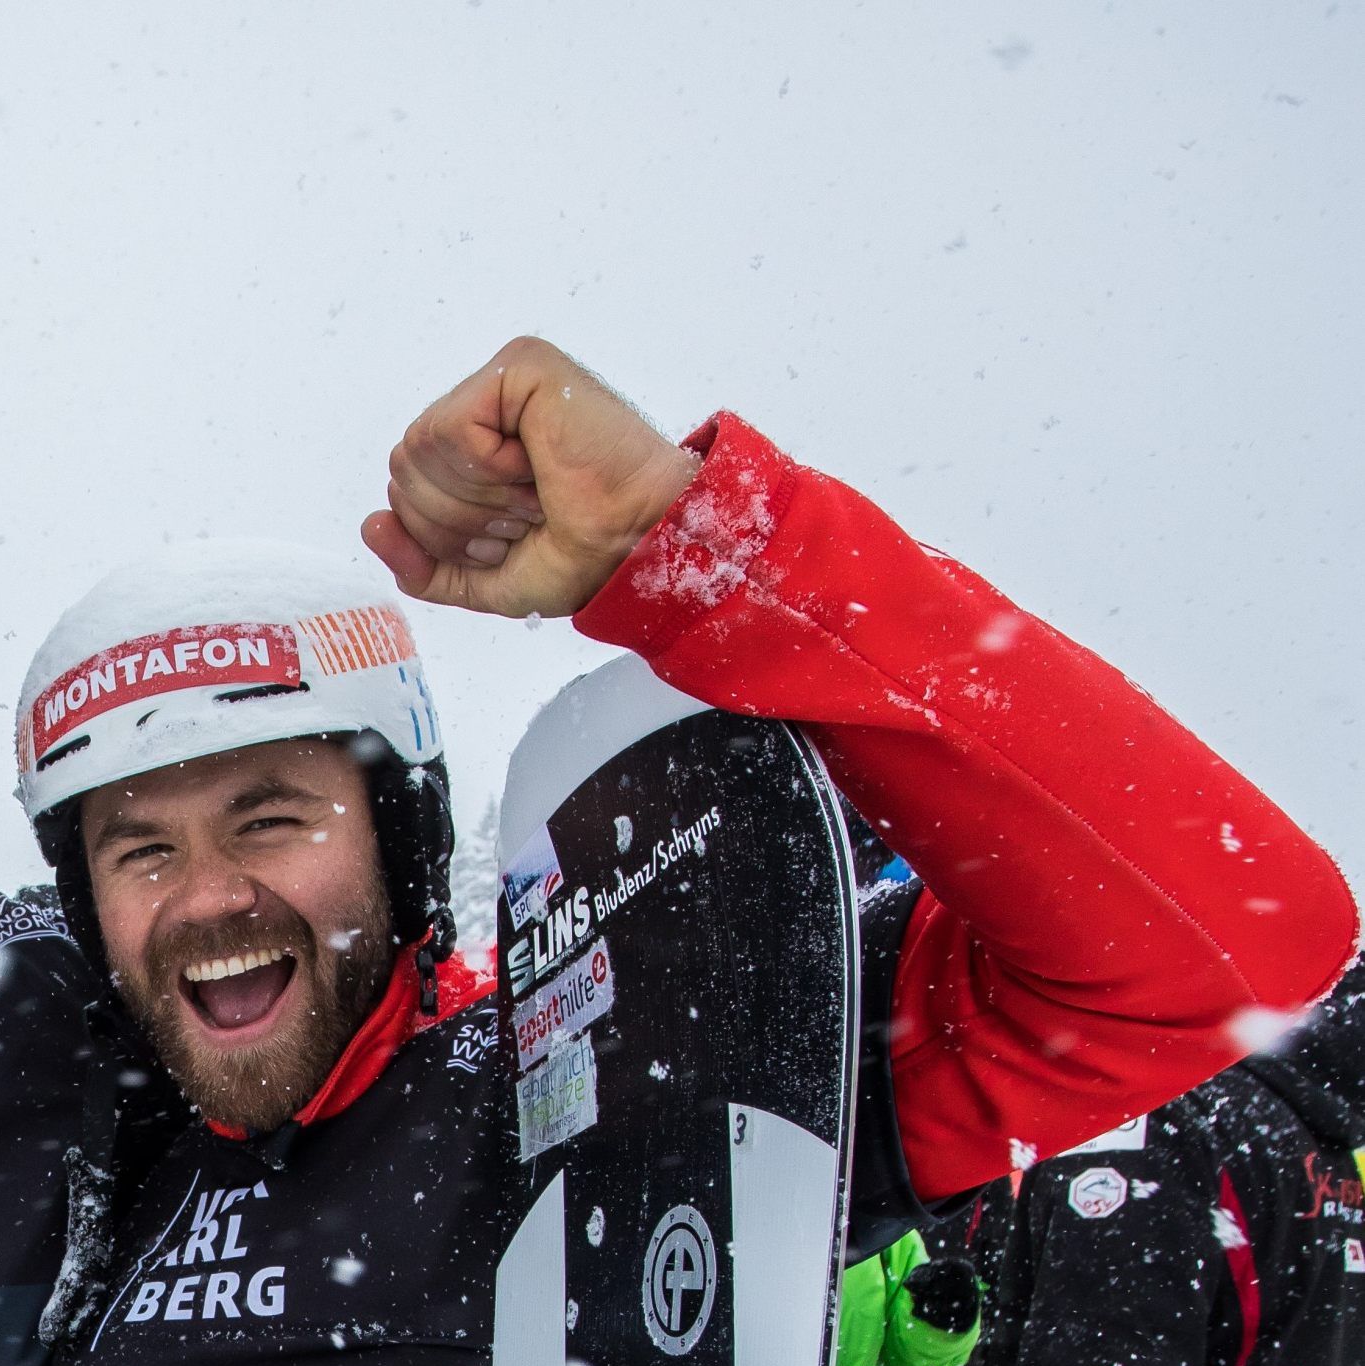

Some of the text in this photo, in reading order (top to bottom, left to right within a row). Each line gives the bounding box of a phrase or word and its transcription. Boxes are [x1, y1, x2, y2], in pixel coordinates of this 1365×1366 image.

[43, 637, 270, 731] MONTAFON
[533, 886, 591, 973] LINS
[518, 972, 595, 1055] sporthilfe
[653, 1212, 710, 1247] APEX
[124, 1266, 286, 1323] BERG
